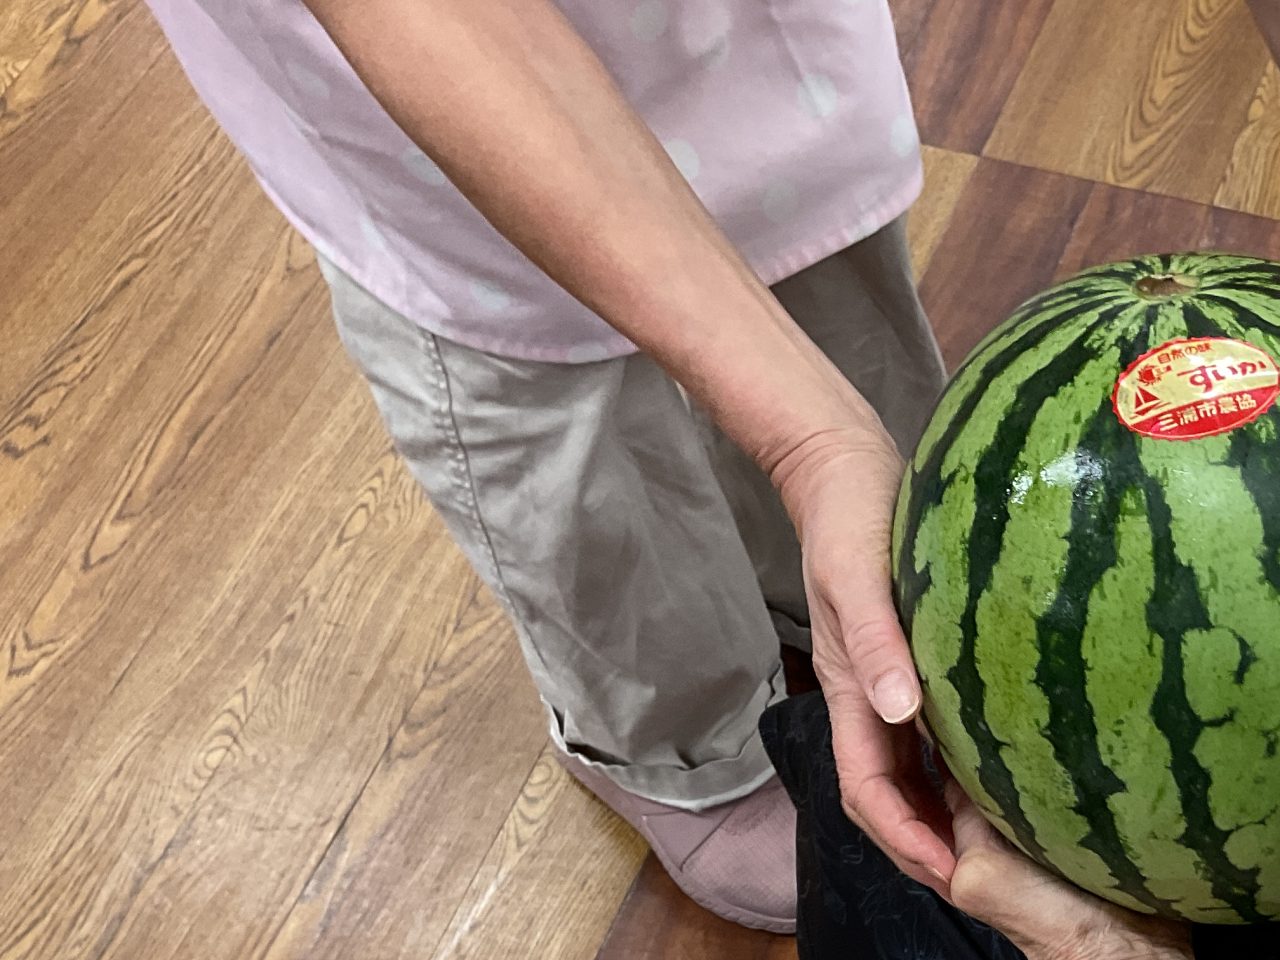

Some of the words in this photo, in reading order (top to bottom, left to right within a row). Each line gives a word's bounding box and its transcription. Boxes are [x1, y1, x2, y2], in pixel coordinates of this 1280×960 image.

[1157, 343, 1212, 364] 自然の味
[1177, 360, 1267, 393] すいか
[1157, 393, 1257, 432] 三浦市農協
